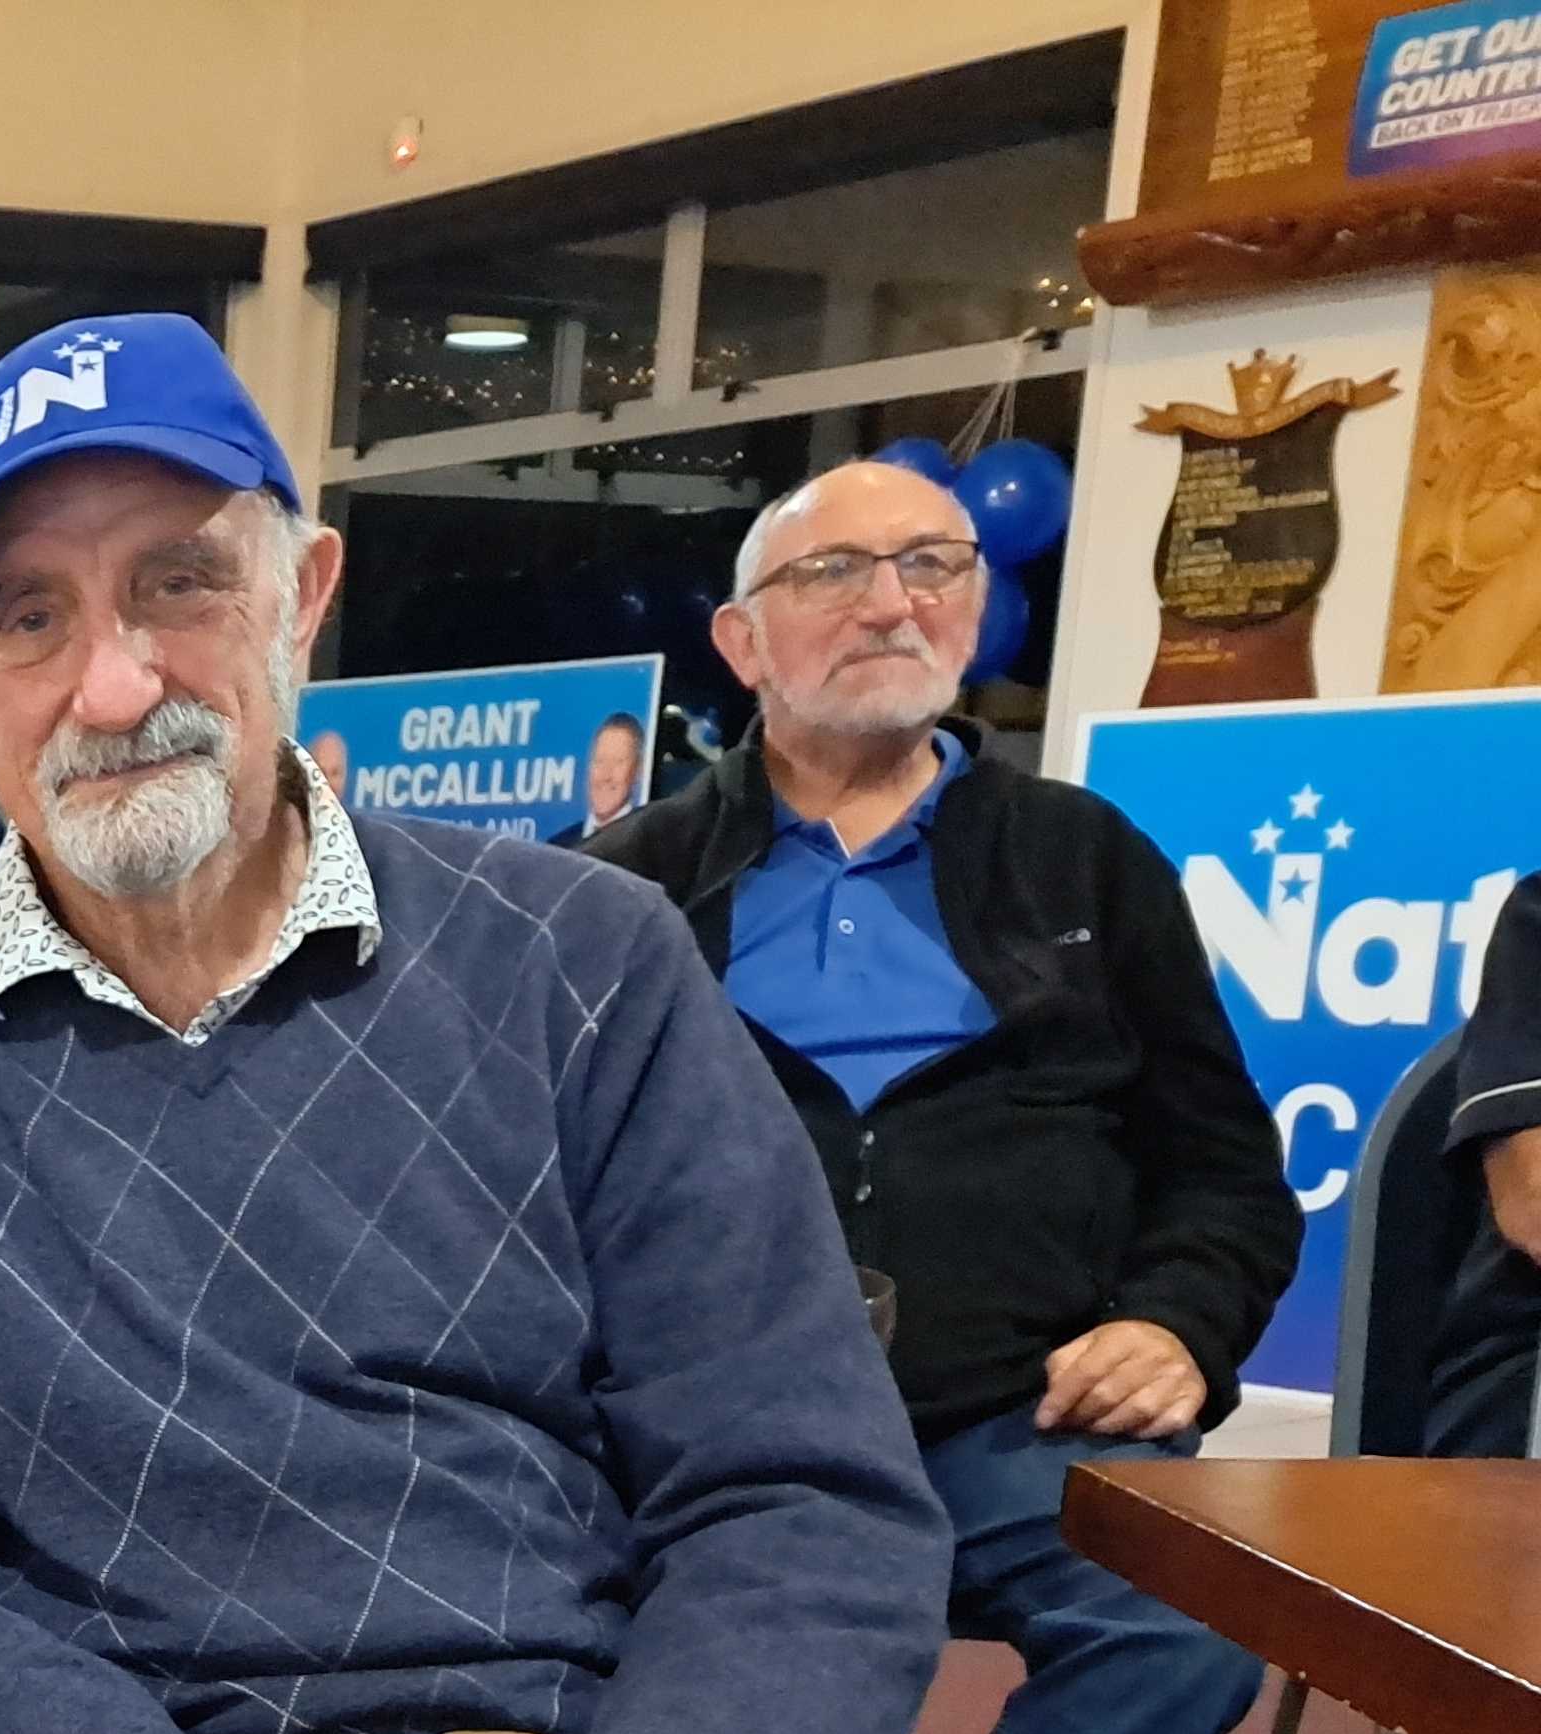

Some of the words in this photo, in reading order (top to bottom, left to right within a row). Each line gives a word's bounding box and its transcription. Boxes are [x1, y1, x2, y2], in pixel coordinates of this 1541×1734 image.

[1392, 26, 1482, 76] GET
[1380, 57, 1541, 115] COUNTR
[400, 699, 541, 752] GRANT
[354, 756, 576, 808] MCCALLUM
